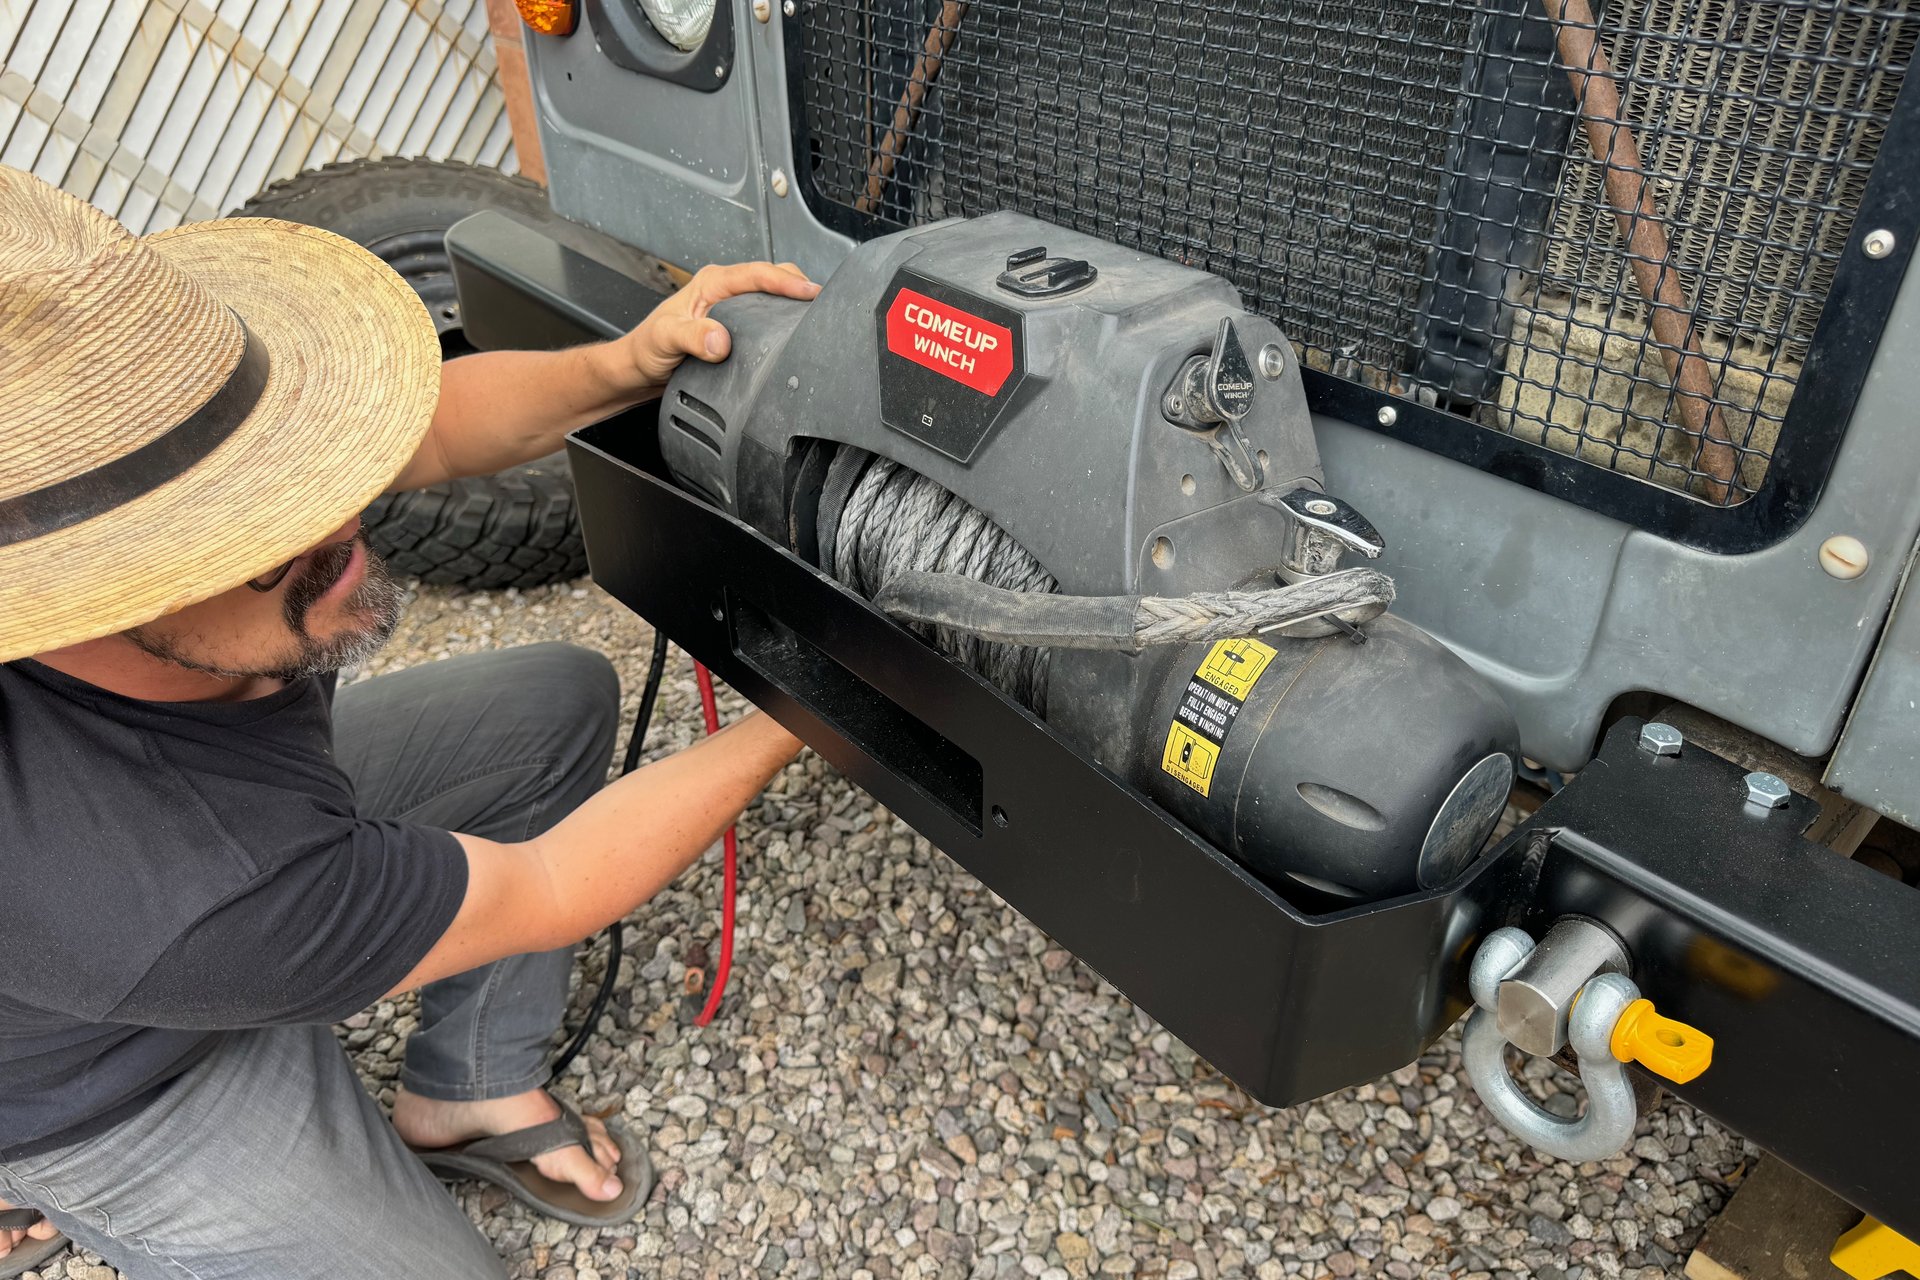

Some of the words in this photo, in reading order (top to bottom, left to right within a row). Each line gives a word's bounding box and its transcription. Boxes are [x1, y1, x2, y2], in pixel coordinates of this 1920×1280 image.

[904, 303, 998, 353] COMEUP
[914, 333, 976, 375] WINCH
[1217, 382, 1253, 391] COMEUP
[1223, 391, 1249, 399] WINCH
[1187, 681, 1218, 705] OPERATION
[1214, 697, 1231, 712] MUST
[1228, 704, 1239, 717] BE
[1204, 671, 1239, 696] ENGAGED
[1178, 705, 1200, 724] BEFORE
[1197, 716, 1225, 739] WINCHING
[1186, 695, 1205, 712] FULLY
[1202, 705, 1227, 726] ENGAGED
[1165, 764, 1205, 794] DISENGAGED
